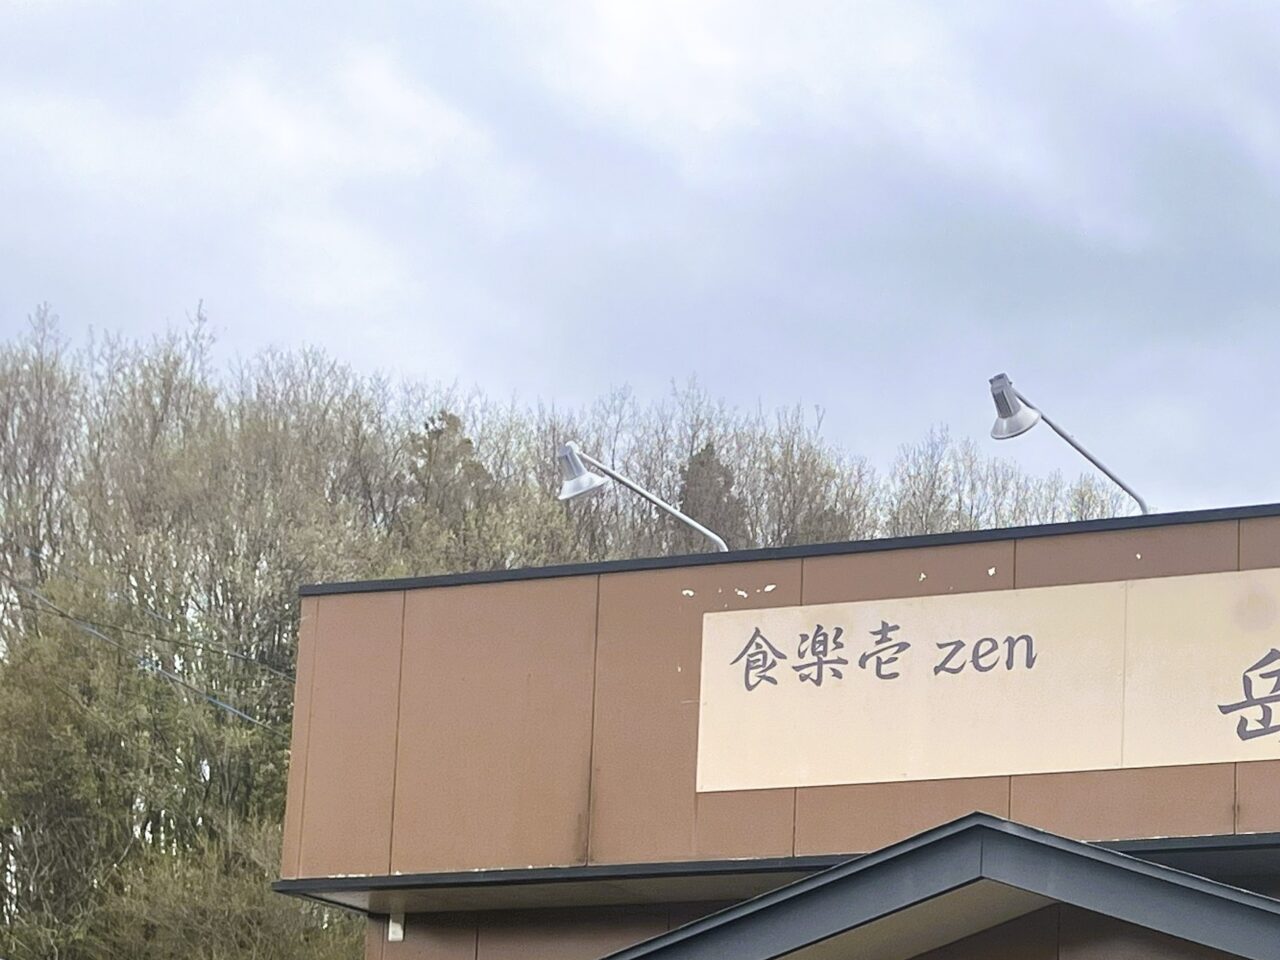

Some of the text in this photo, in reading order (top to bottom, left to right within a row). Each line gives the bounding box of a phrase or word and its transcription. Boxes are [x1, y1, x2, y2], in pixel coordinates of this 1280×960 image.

[729, 620, 1037, 692] 食楽壱 zen
